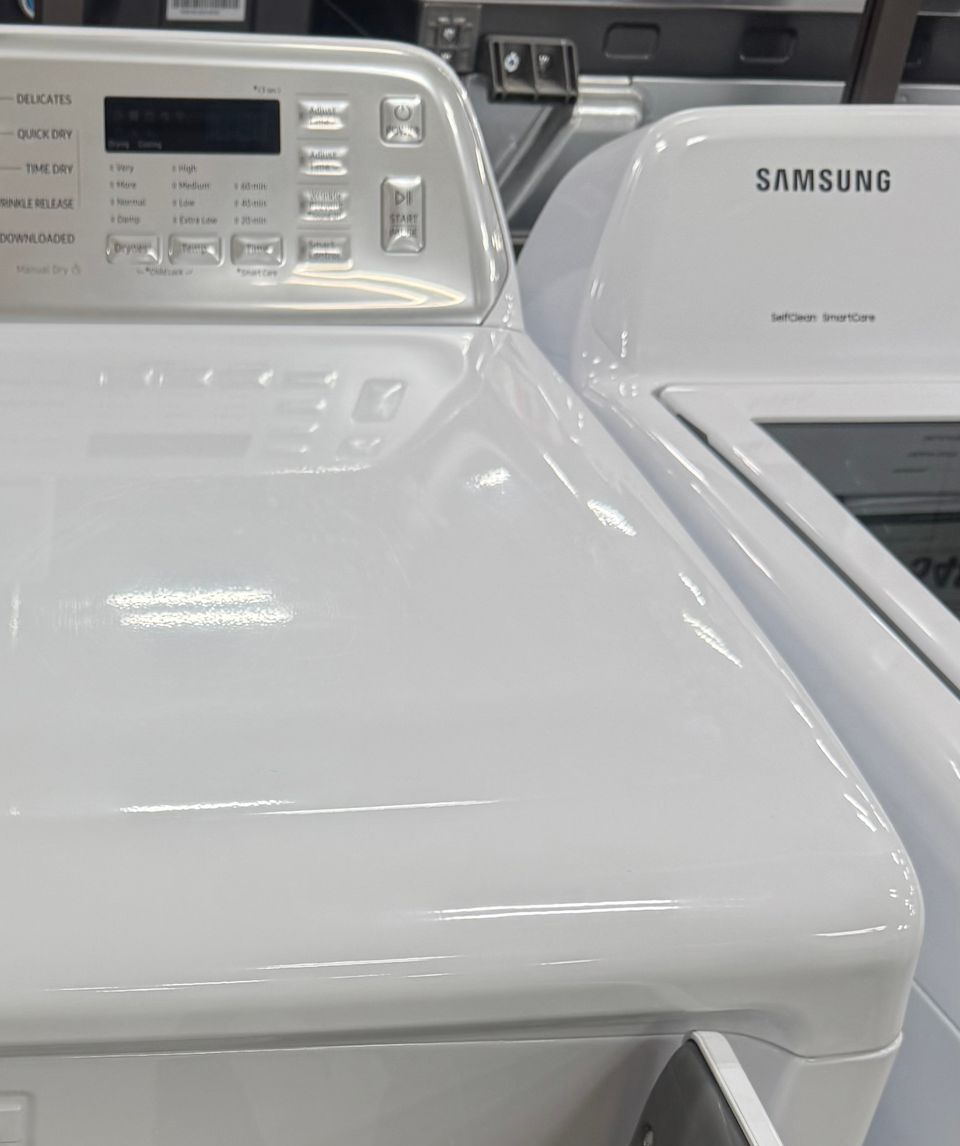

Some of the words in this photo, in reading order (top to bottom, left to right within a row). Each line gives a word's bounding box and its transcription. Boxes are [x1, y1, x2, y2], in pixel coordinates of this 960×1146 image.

[16, 94, 72, 105] DELICATES
[17, 129, 49, 140] QUICK
[51, 129, 72, 140] DRY
[26, 163, 50, 175] TIME
[52, 163, 73, 175] DRY
[756, 168, 892, 192] SAMSUNG
[35, 198, 74, 209] RELEASE
[390, 214, 418, 223] START
[0, 233, 75, 245] DOWNLOADED
[771, 312, 817, 322] SelfClean
[823, 313, 875, 322] SmartCare
